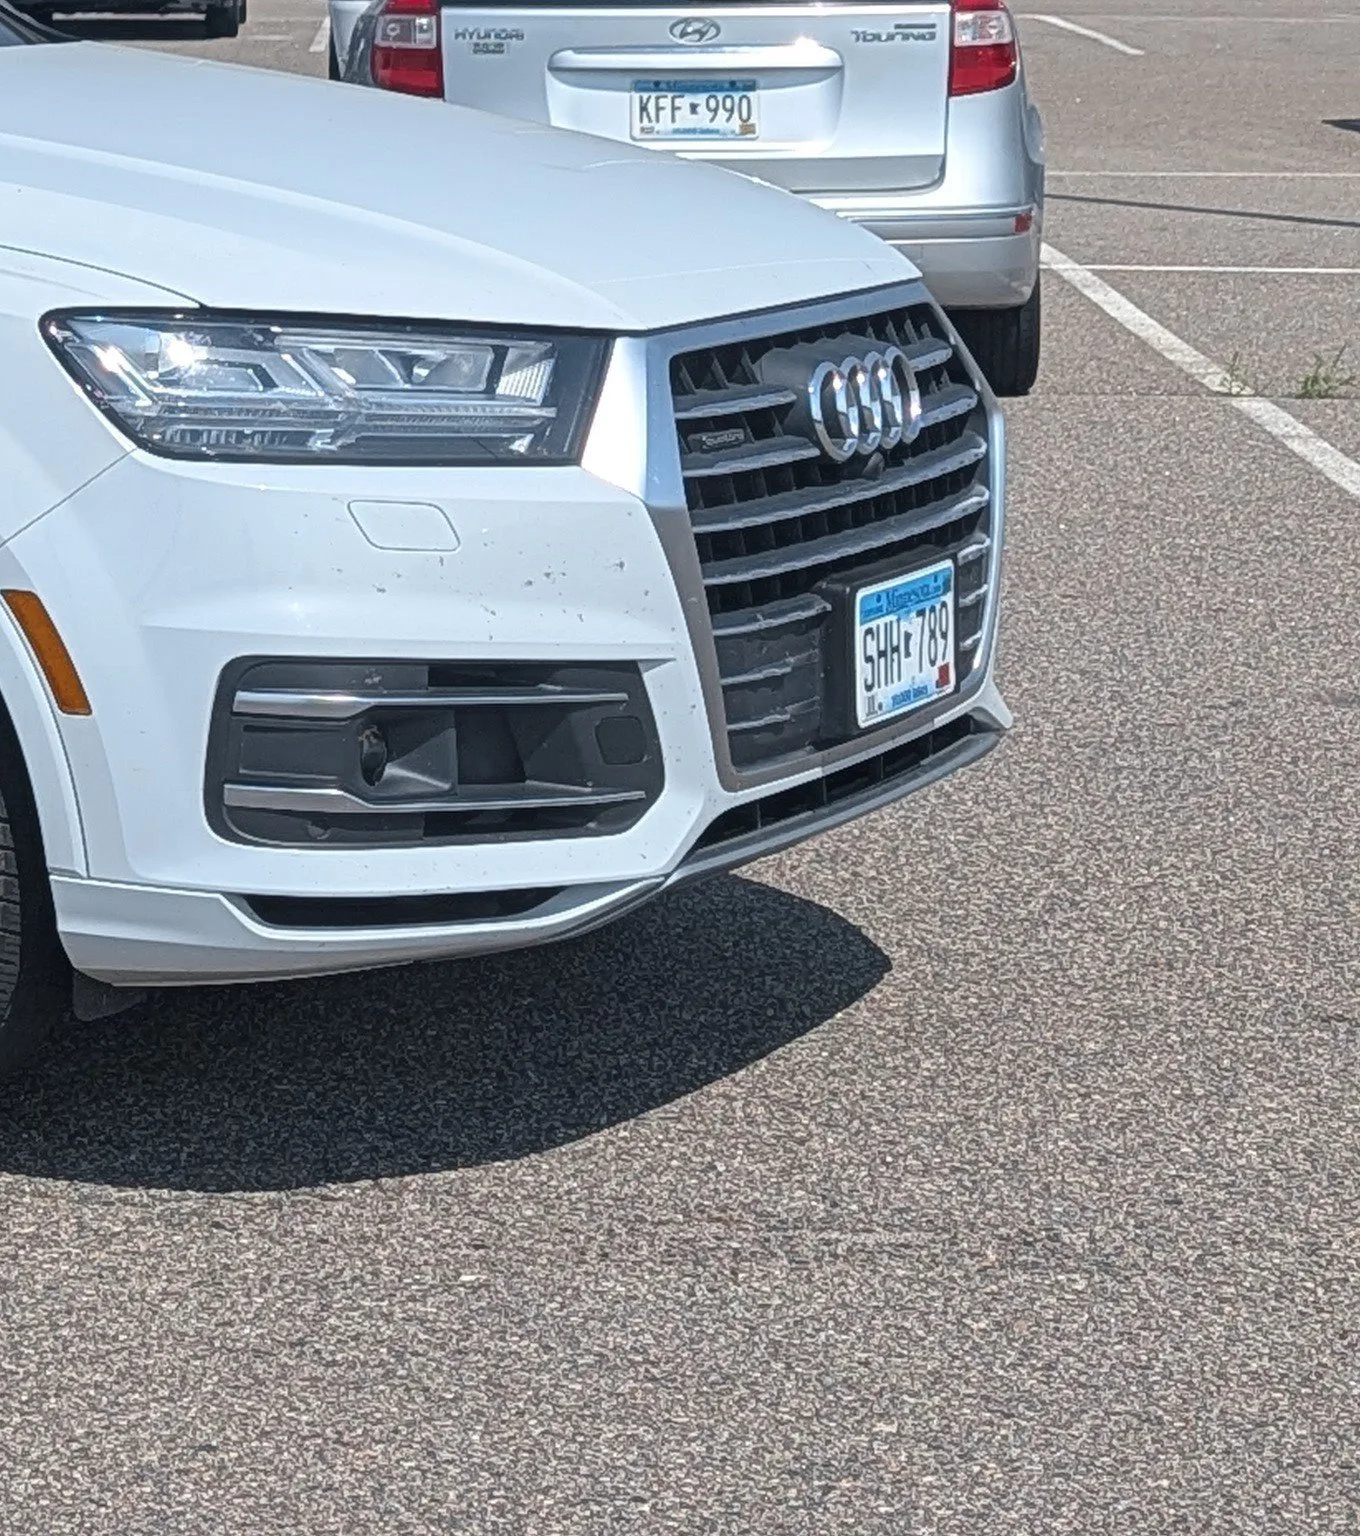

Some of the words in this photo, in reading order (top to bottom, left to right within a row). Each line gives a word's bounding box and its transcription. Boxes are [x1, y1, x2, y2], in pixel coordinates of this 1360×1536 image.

[639, 94, 685, 124] KFF
[705, 94, 752, 124] 990
[863, 616, 901, 693] SHH
[916, 600, 949, 674] 789
